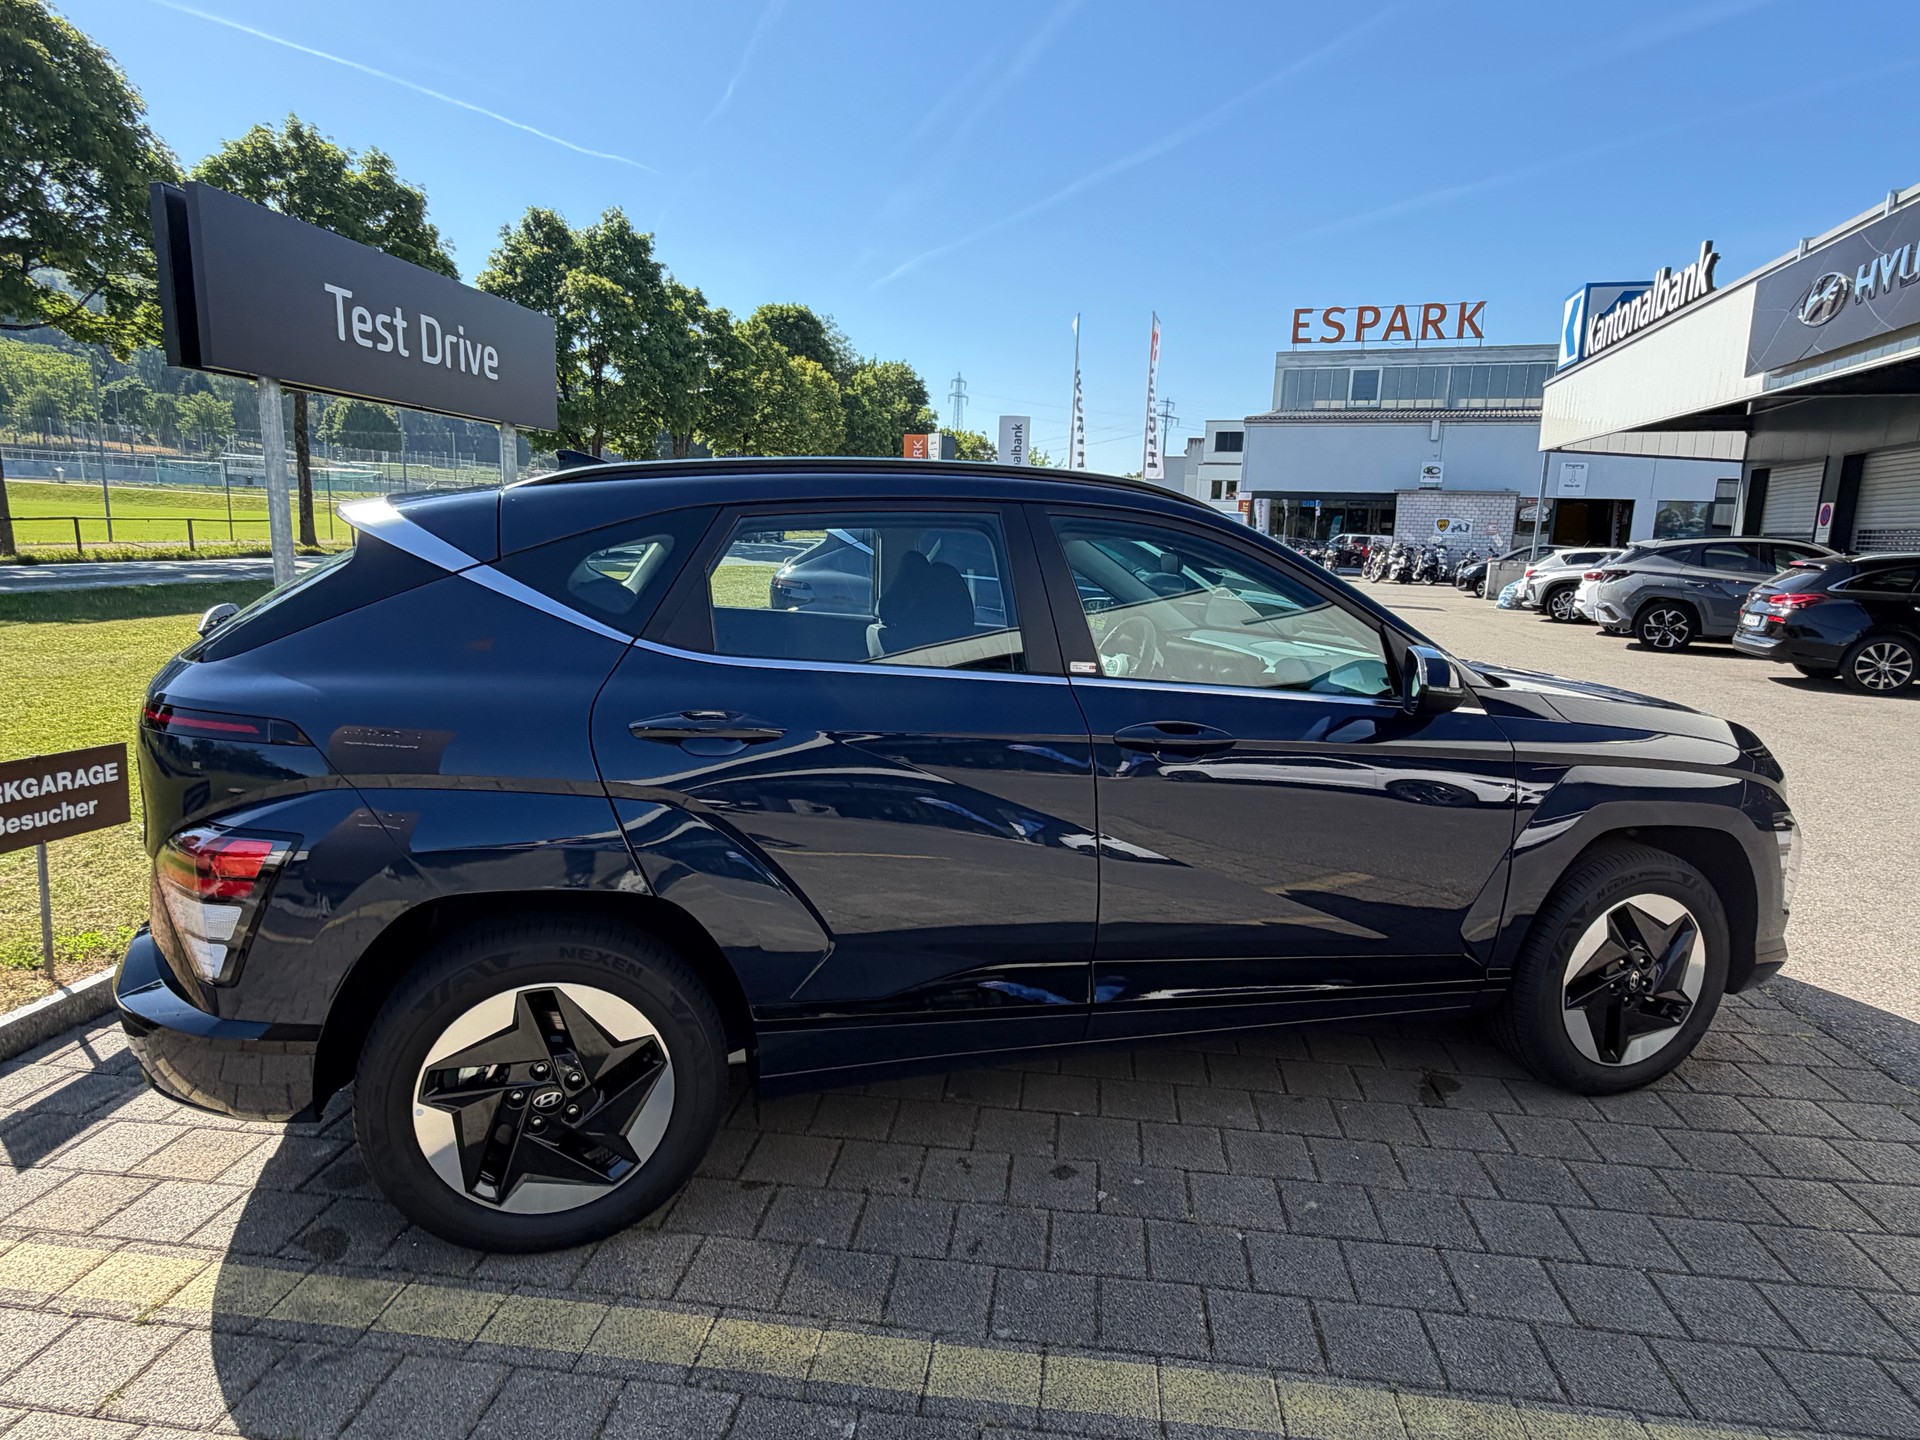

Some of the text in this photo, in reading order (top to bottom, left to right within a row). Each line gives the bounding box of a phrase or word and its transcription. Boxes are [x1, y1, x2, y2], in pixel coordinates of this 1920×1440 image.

[1583, 241, 1717, 357] Kantonalbank
[324, 283, 499, 381] Test Drive
[1292, 301, 1487, 344] ESPARK
[1010, 423, 1024, 465] albank
[0, 762, 119, 804] KGARAGE
[559, 946, 643, 979] NEXEN
